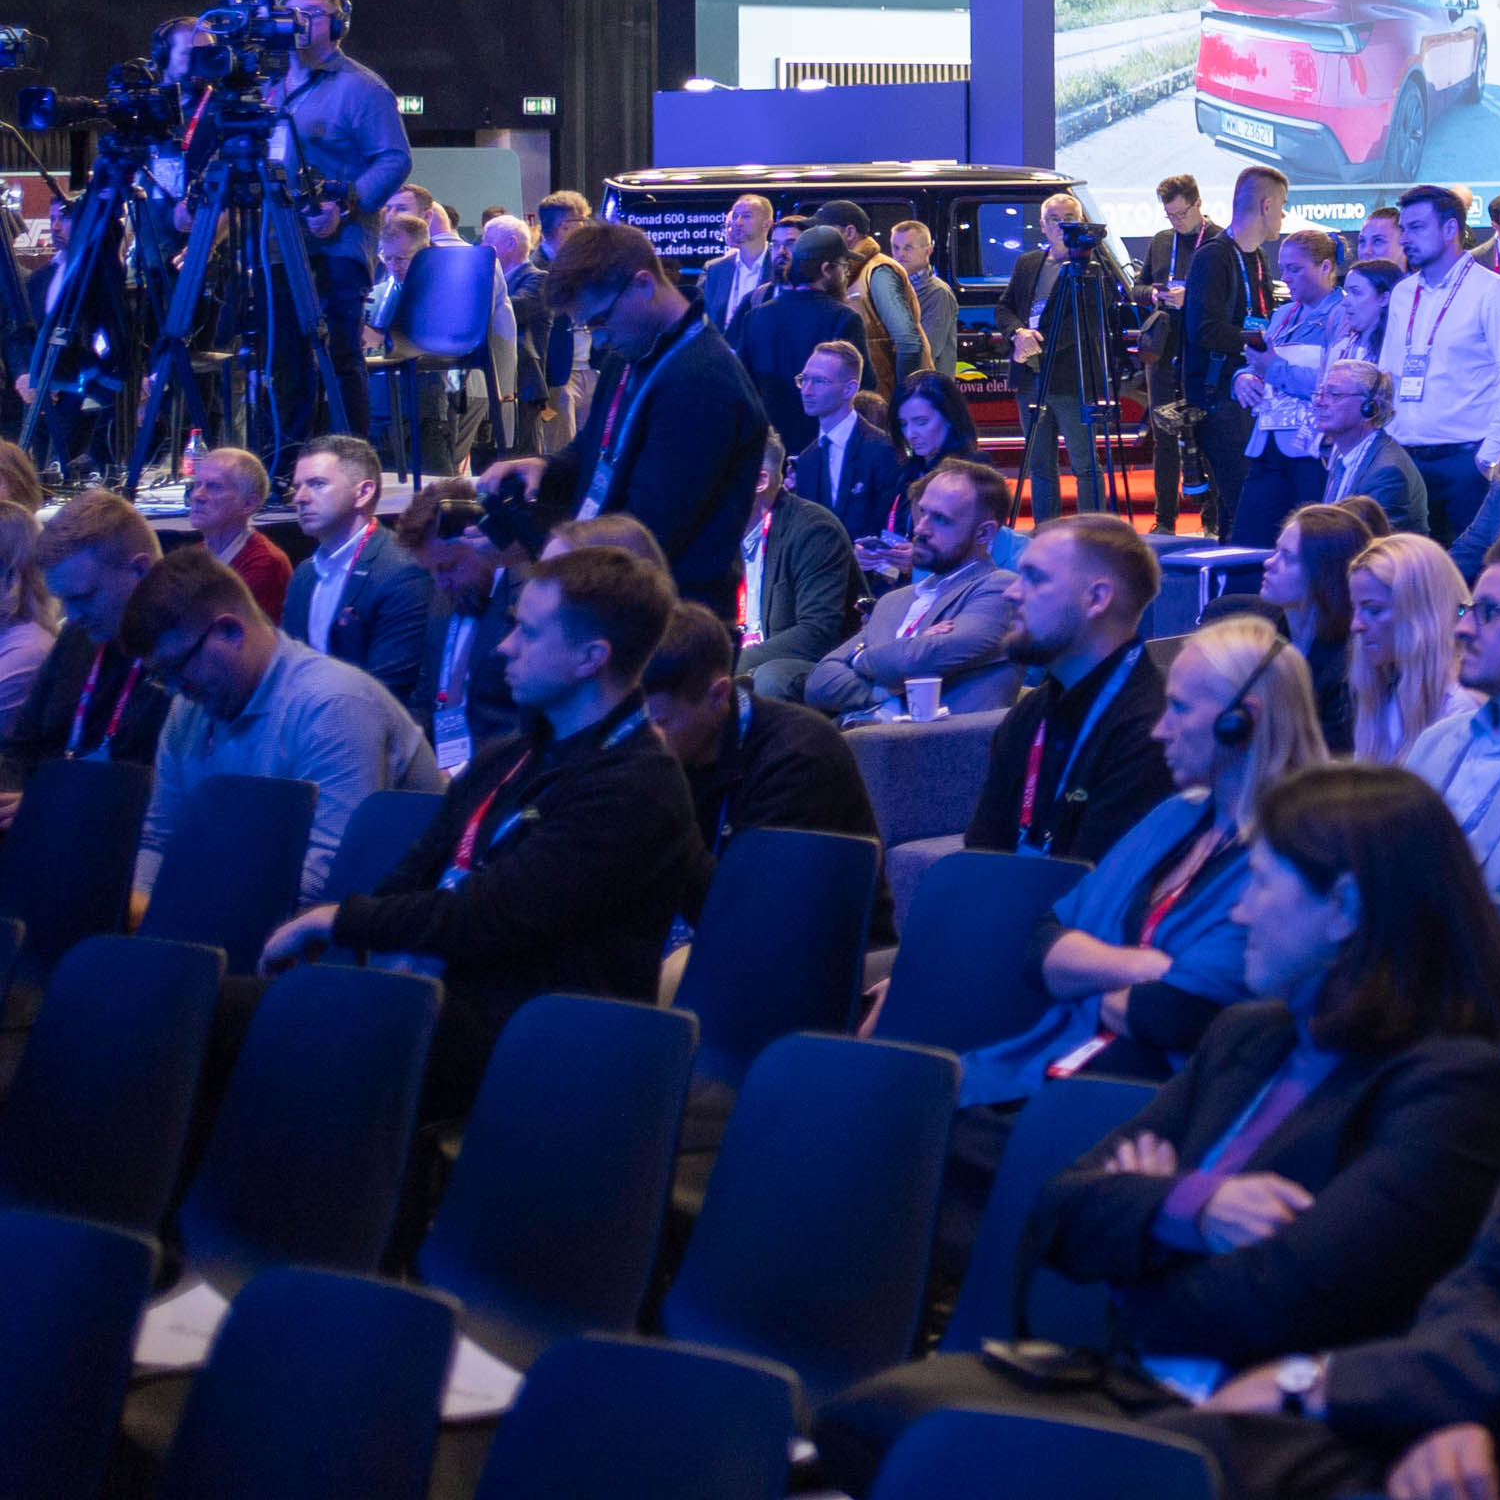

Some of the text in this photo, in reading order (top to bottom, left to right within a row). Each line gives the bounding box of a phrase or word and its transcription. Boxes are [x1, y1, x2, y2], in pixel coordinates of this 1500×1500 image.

[1288, 202, 1366, 220] AUTOVIT.RO
[628, 212, 729, 226] Ponad 600 samoch
[692, 228, 707, 240] od
[654, 244, 731, 257] a.duda-cars.p
